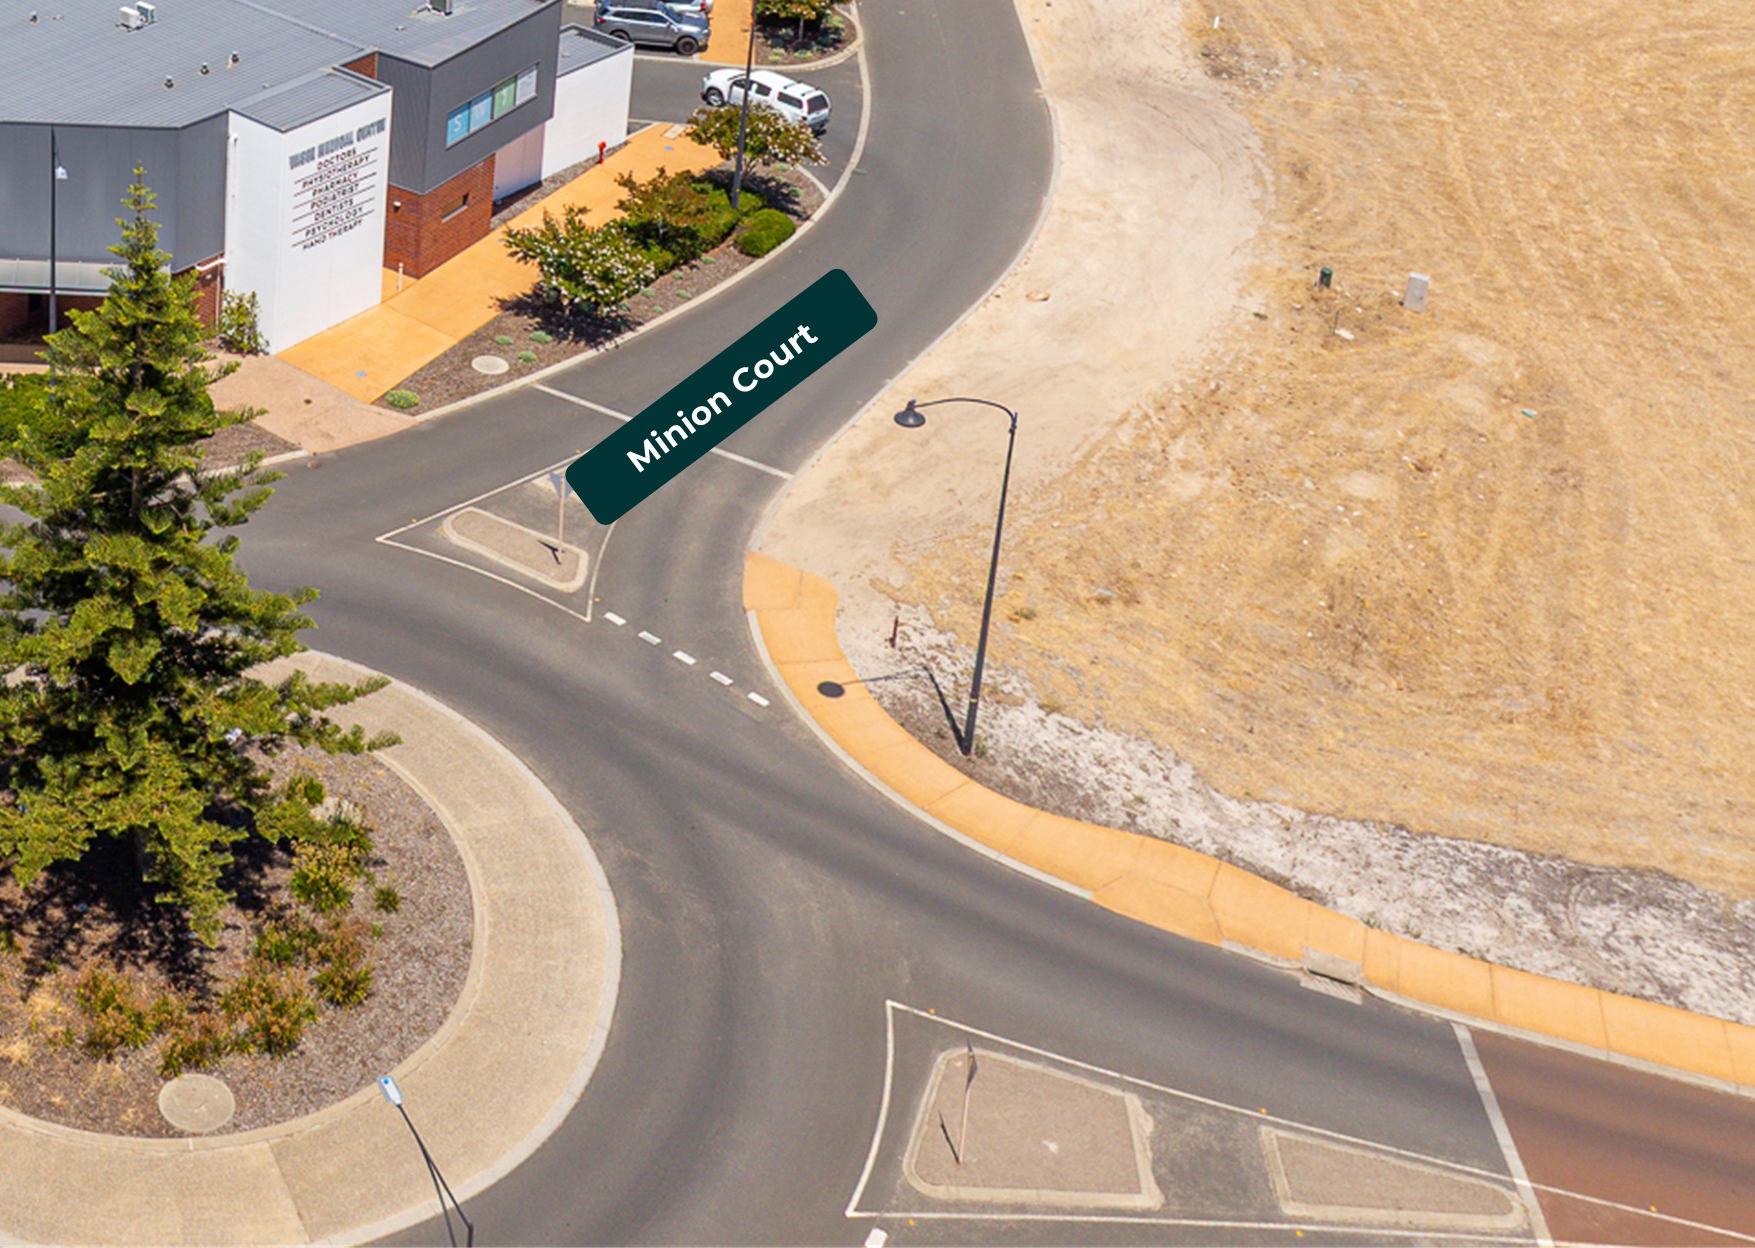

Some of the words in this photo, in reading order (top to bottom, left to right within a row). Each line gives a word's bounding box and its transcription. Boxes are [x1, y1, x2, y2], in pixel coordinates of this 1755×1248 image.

[317, 148, 357, 170] DOCTORS
[302, 155, 370, 188] PHYSIOTHERAPY
[310, 183, 359, 209] PODIATRIST
[312, 173, 359, 197] PHARMACY
[305, 207, 363, 237] PSYCHOLOGY
[314, 199, 354, 221] DENTISTS
[328, 219, 363, 239] THERAPY
